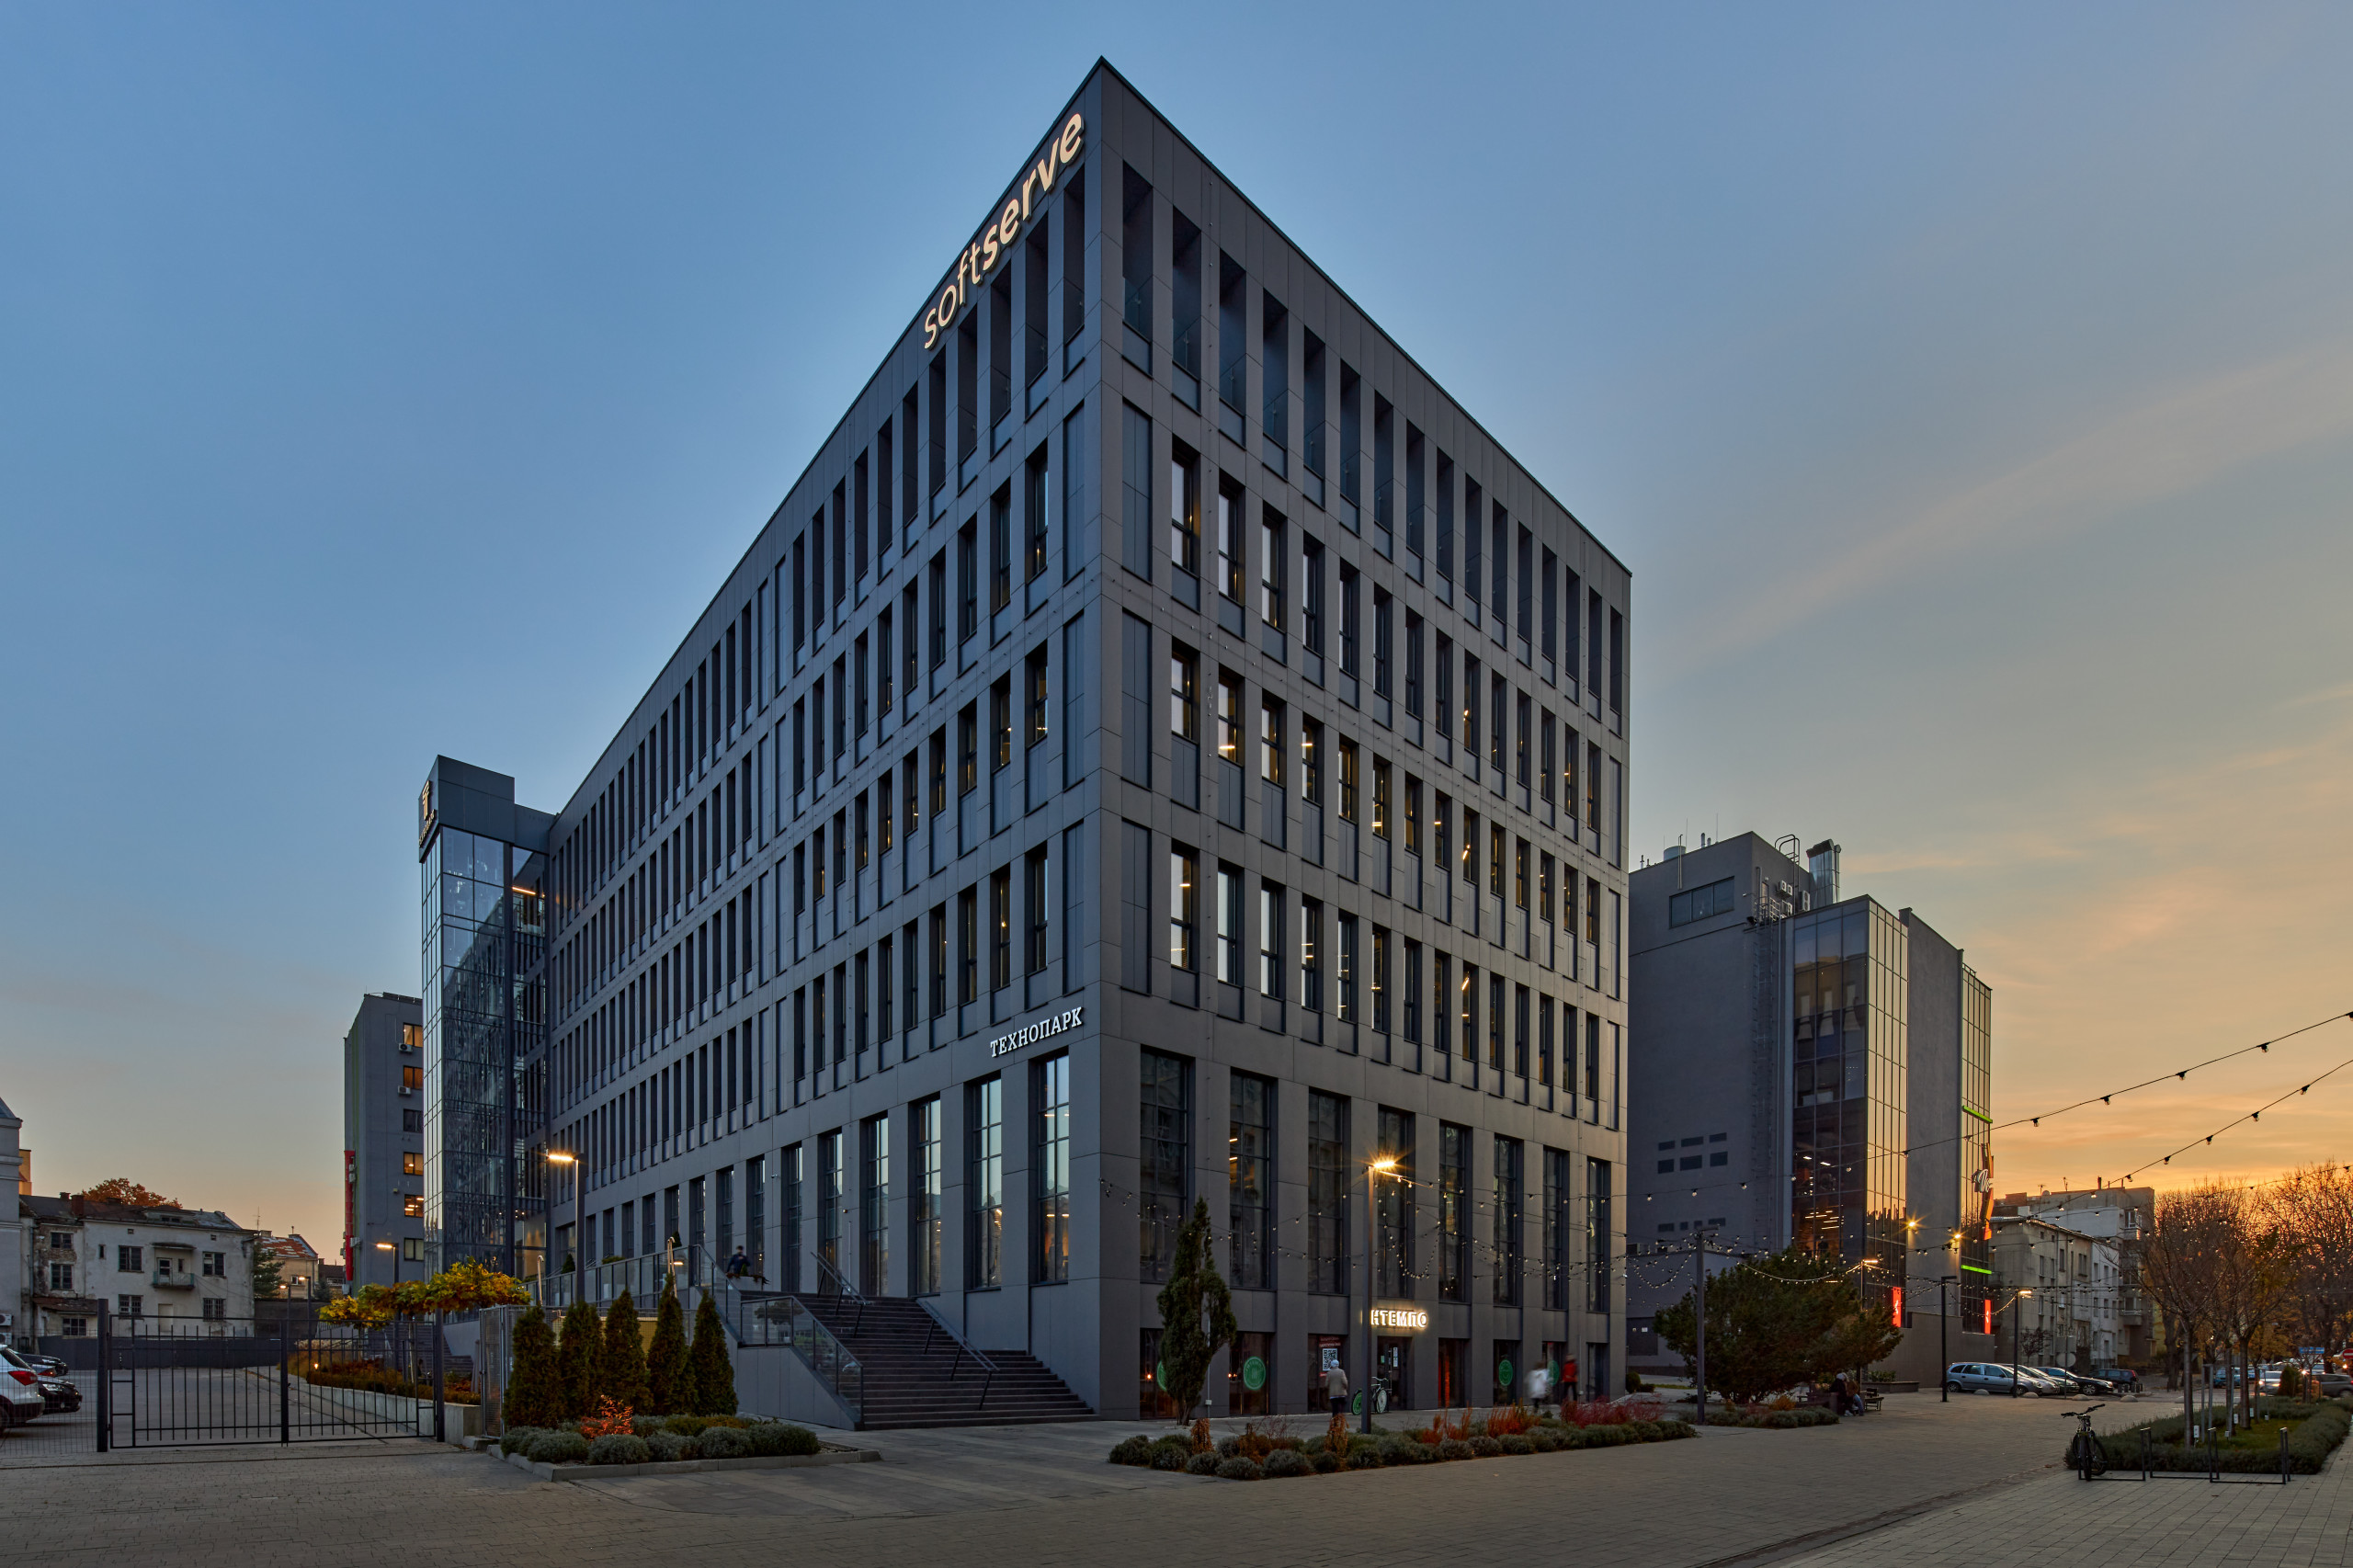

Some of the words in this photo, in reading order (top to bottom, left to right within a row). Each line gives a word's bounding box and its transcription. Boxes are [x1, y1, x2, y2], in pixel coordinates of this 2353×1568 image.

[924, 112, 1086, 349] softserve
[990, 1006, 1083, 1058] ТЕХНОПАРК
[1362, 1309, 1427, 1328] НТЕМПО
